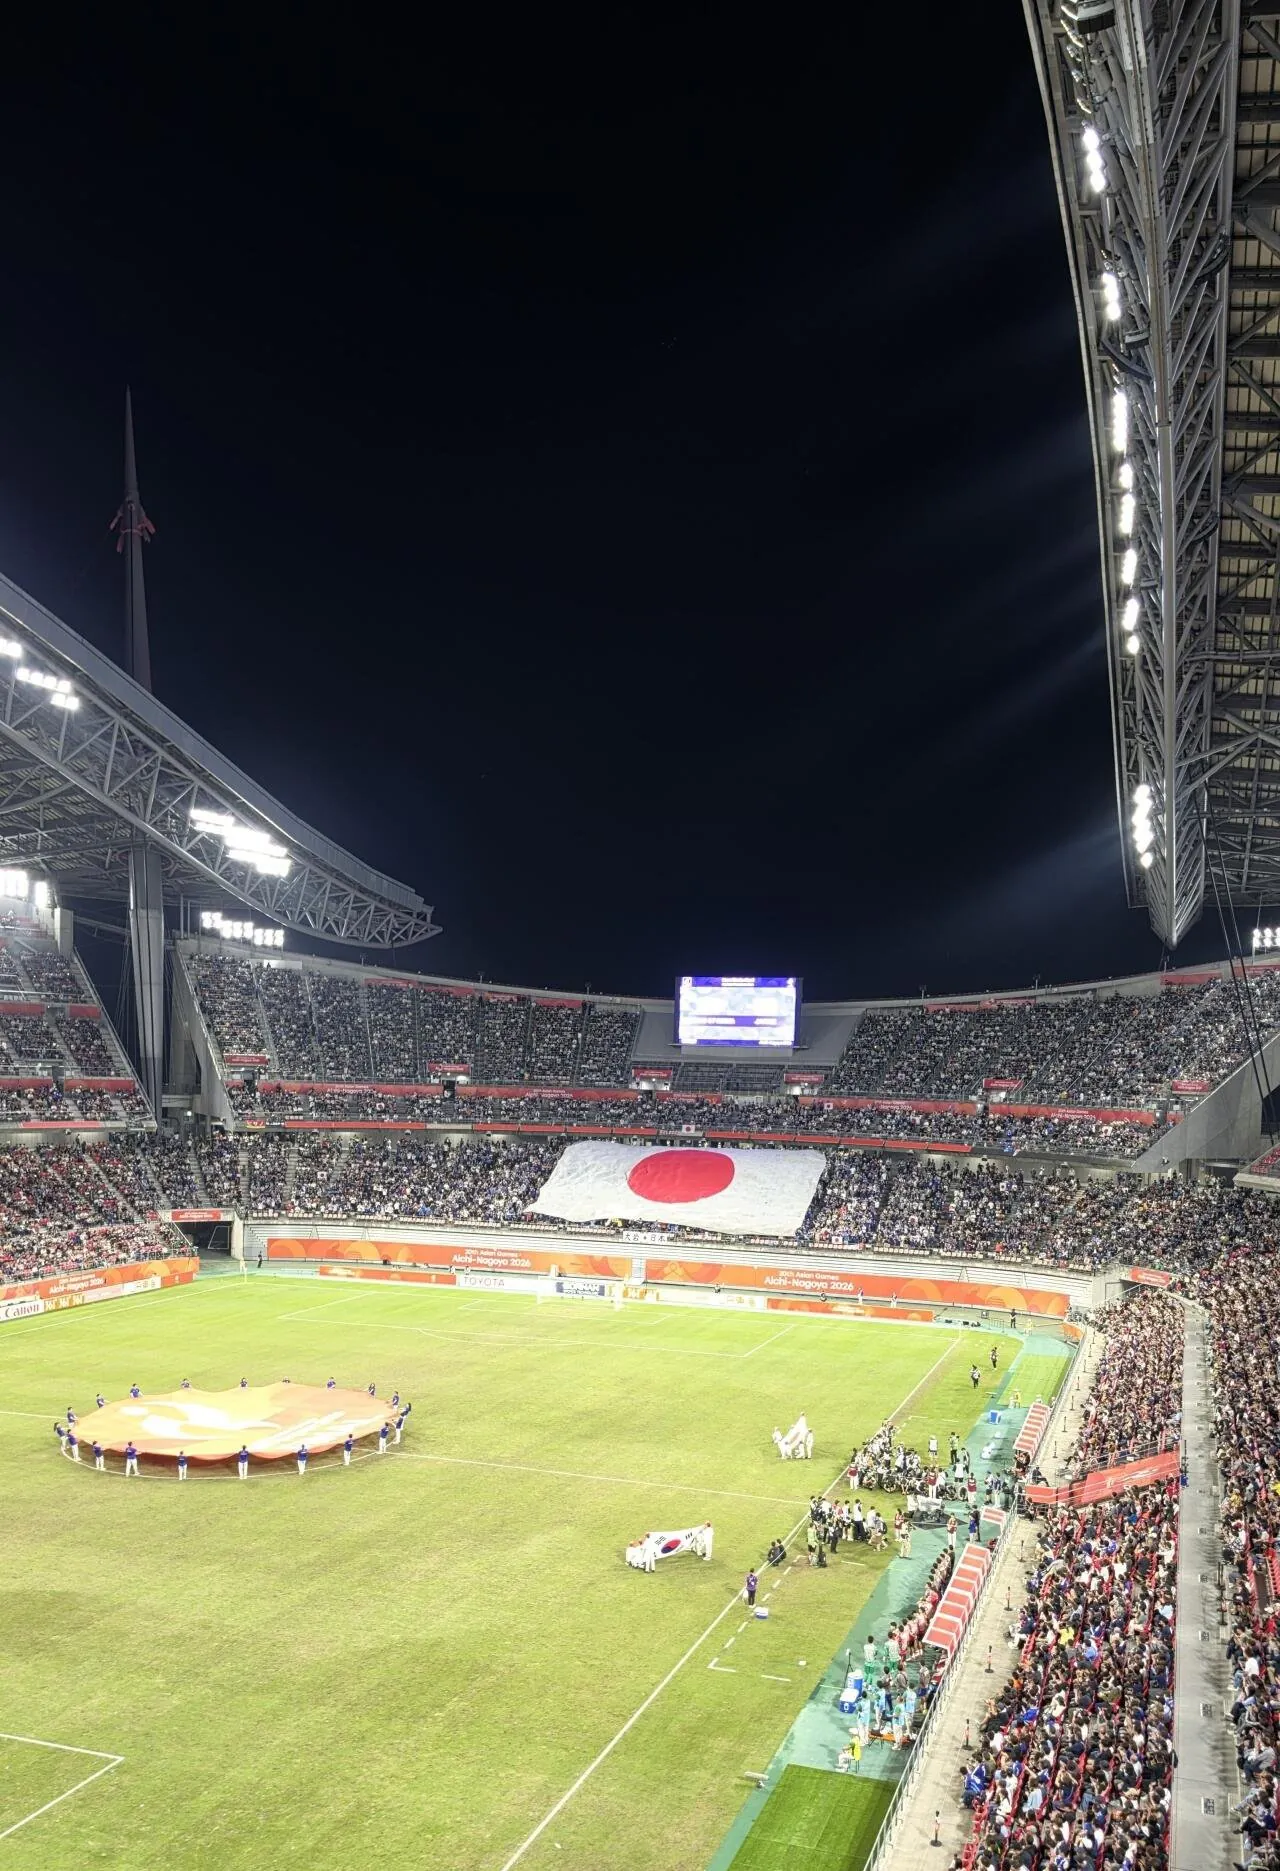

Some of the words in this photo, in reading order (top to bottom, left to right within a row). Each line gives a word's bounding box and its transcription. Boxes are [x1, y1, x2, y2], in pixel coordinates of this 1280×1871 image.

[452, 1254, 509, 1267] Aichi-Nagoya
[509, 1257, 531, 1267] 2026
[464, 1276, 505, 1287] TOYOTA
[795, 1271, 814, 1279] Asian
[815, 1273, 839, 1281] Games
[764, 1275, 828, 1290] Aichi-Nagoya
[830, 1281, 854, 1291] 2026
[5, 1303, 39, 1318] Canon
